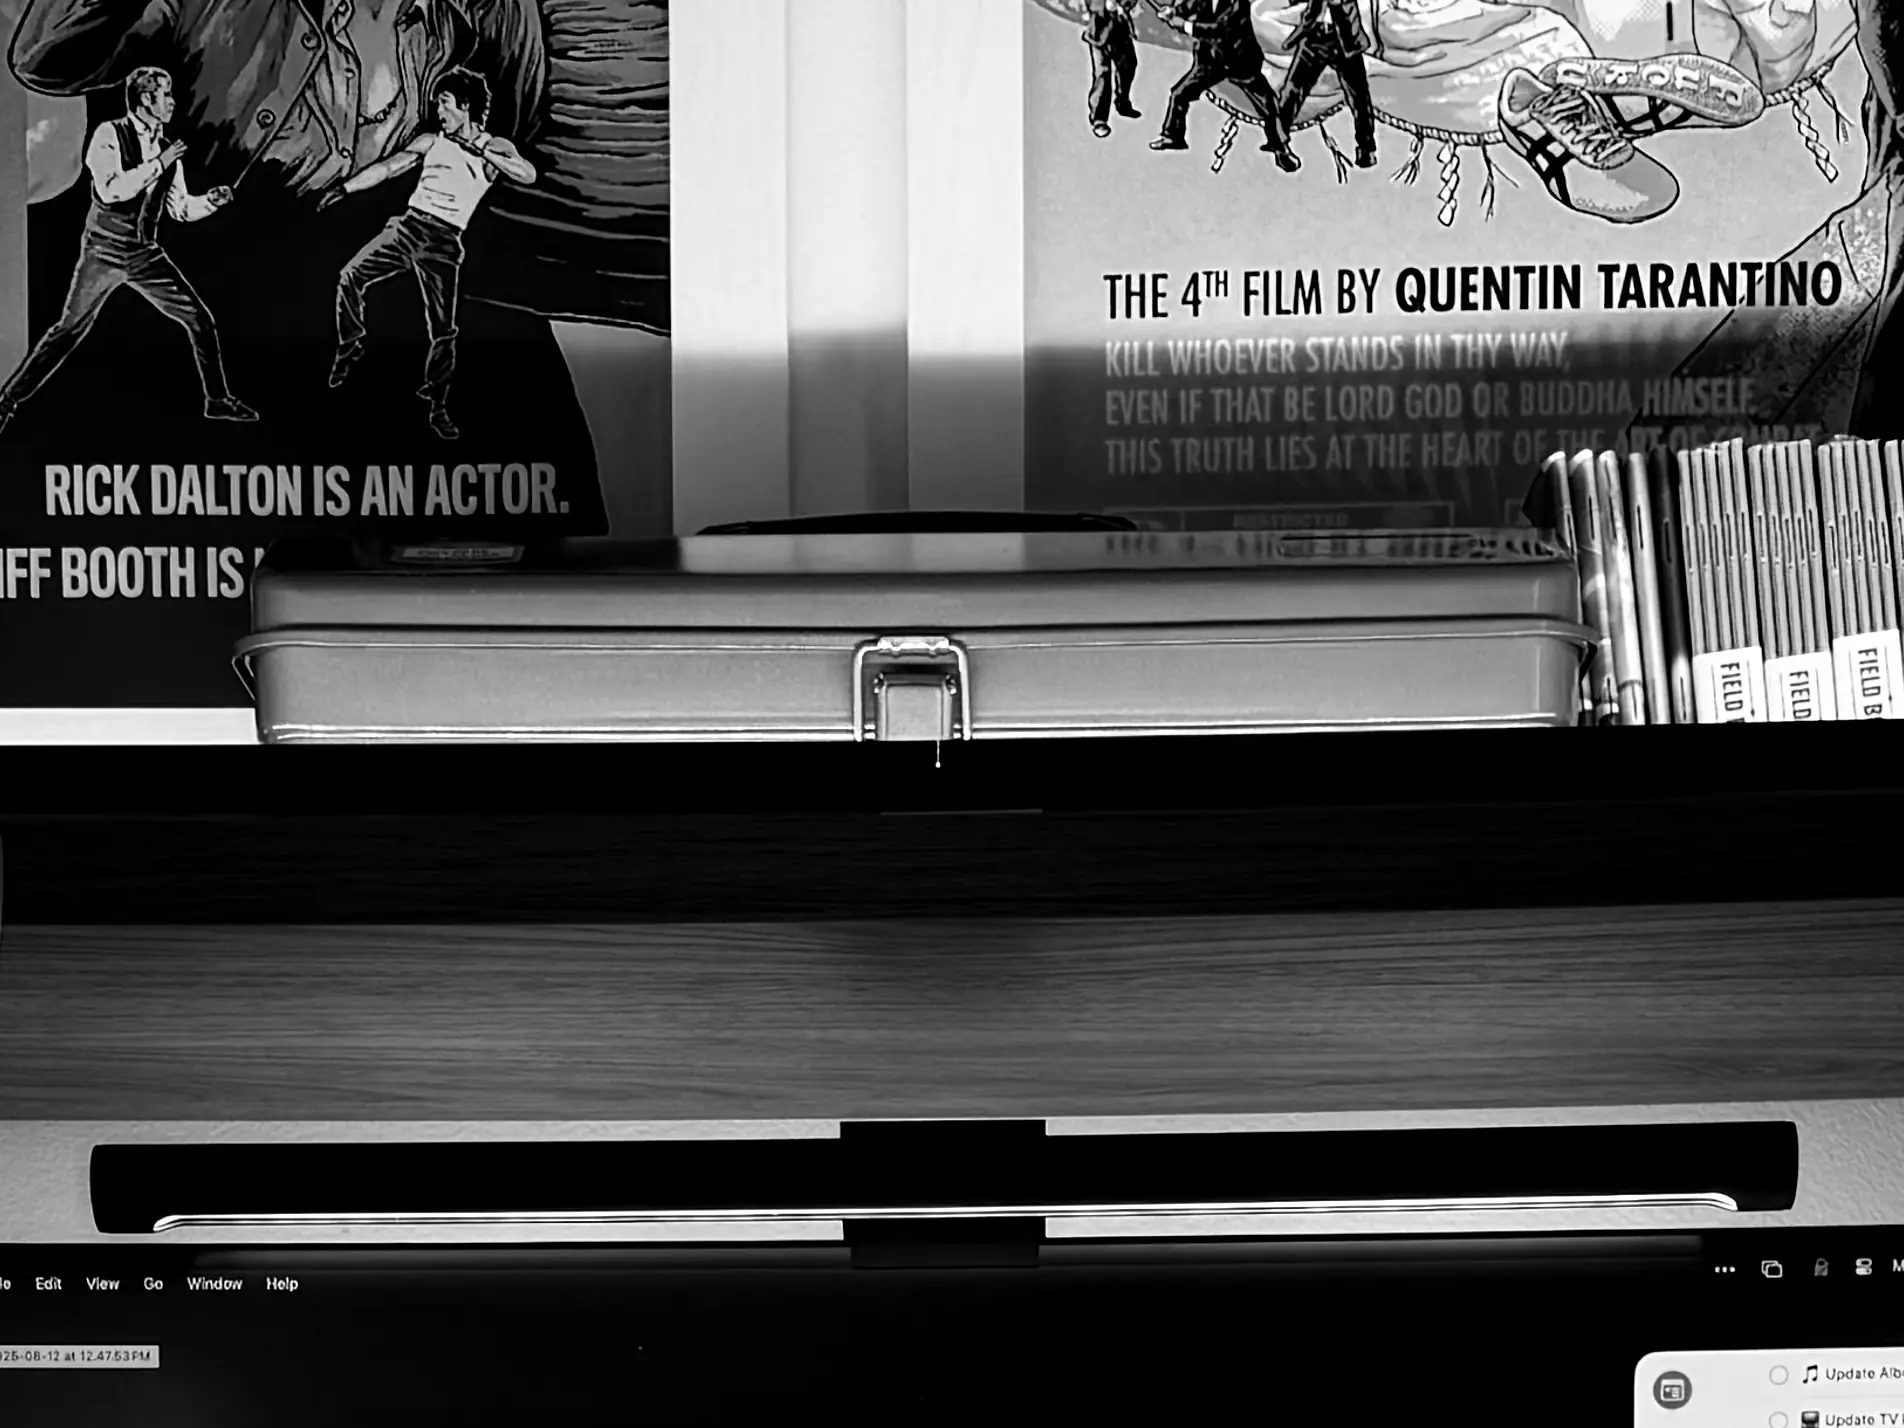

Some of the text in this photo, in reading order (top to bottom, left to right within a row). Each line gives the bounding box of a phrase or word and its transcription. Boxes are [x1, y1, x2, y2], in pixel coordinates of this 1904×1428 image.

[1103, 260, 1843, 319] THE 4TH FILM BY QUENTIN TARANTINO
[1105, 330, 1571, 377] KILL WHOEVER STANDS IN THY WAY,
[1105, 389, 1169, 426] EVEN
[1178, 387, 1202, 424] IF
[1210, 386, 1277, 424] THAT
[1283, 385, 1316, 422] BE
[1324, 383, 1395, 422] LORD
[1404, 382, 1463, 421] GOD
[1471, 381, 1509, 419] OR
[1518, 379, 1635, 418] BUDDHA
[1105, 438, 1162, 476] THIS
[1171, 436, 1255, 474] TRUTH
[1265, 434, 1316, 471] LIES
[1325, 433, 1354, 470] AT
[1363, 432, 1412, 470] THE
[1421, 430, 1505, 469] HEART
[45, 462, 571, 517] RICK DALTON IS AN ACTOR.
[61, 546, 196, 599] BOOTH
[206, 546, 245, 598] IS
[1720, 662, 1745, 713] FIELD
[1788, 670, 1812, 720] FIELD
[1858, 648, 1882, 698] FIELD
[35, 1276, 63, 1291] Edit
[85, 1276, 121, 1291] View
[143, 1277, 164, 1291] Go
[187, 1276, 244, 1291] Window
[265, 1276, 300, 1293] Help
[64, 1350, 77, 1363] at
[1825, 1366, 1876, 1382] Update
[1825, 1412, 1876, 1428] Update
[1880, 1412, 1899, 1426] TV
